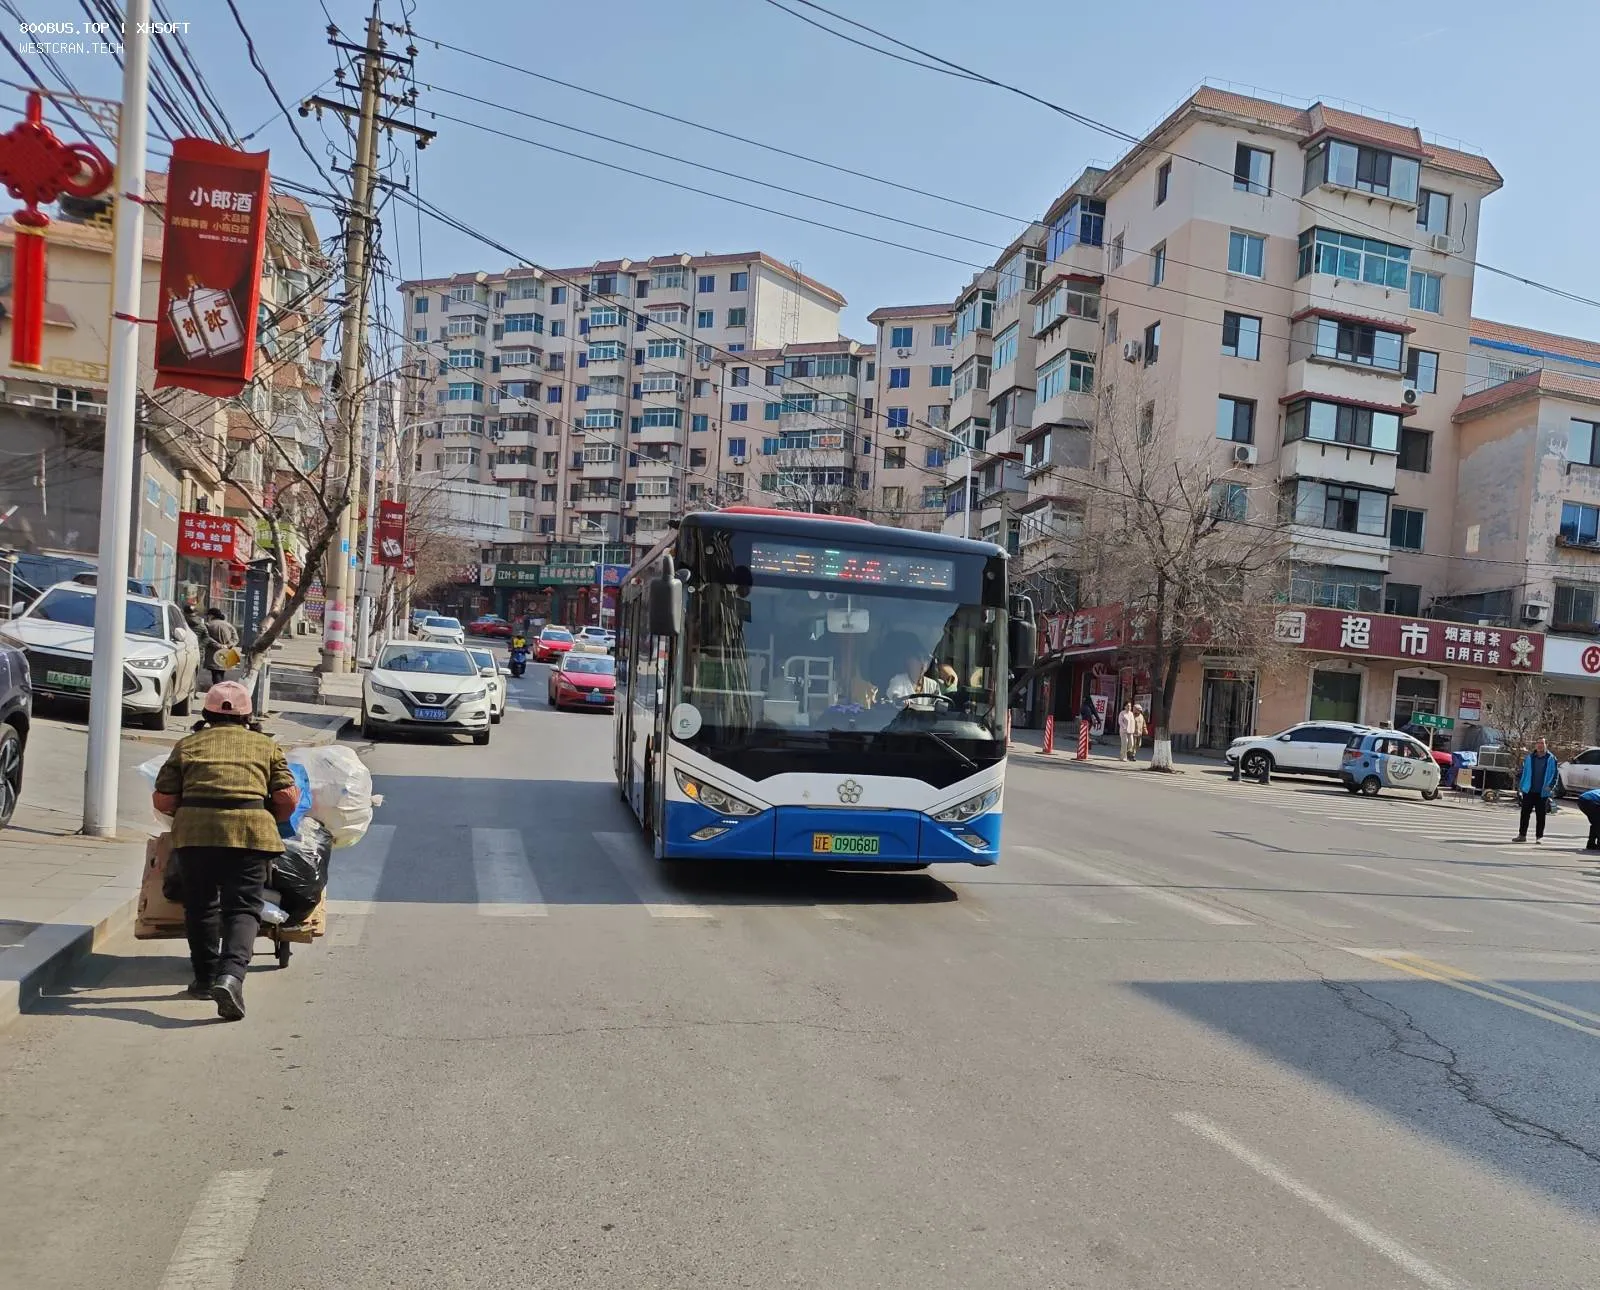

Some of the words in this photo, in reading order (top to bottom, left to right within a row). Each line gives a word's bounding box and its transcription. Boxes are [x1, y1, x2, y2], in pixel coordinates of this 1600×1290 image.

[189, 186, 253, 212] 小郎酒
[1445, 626, 1501, 647] 烟酒糖茶
[1445, 646, 1501, 665] 日用百货
